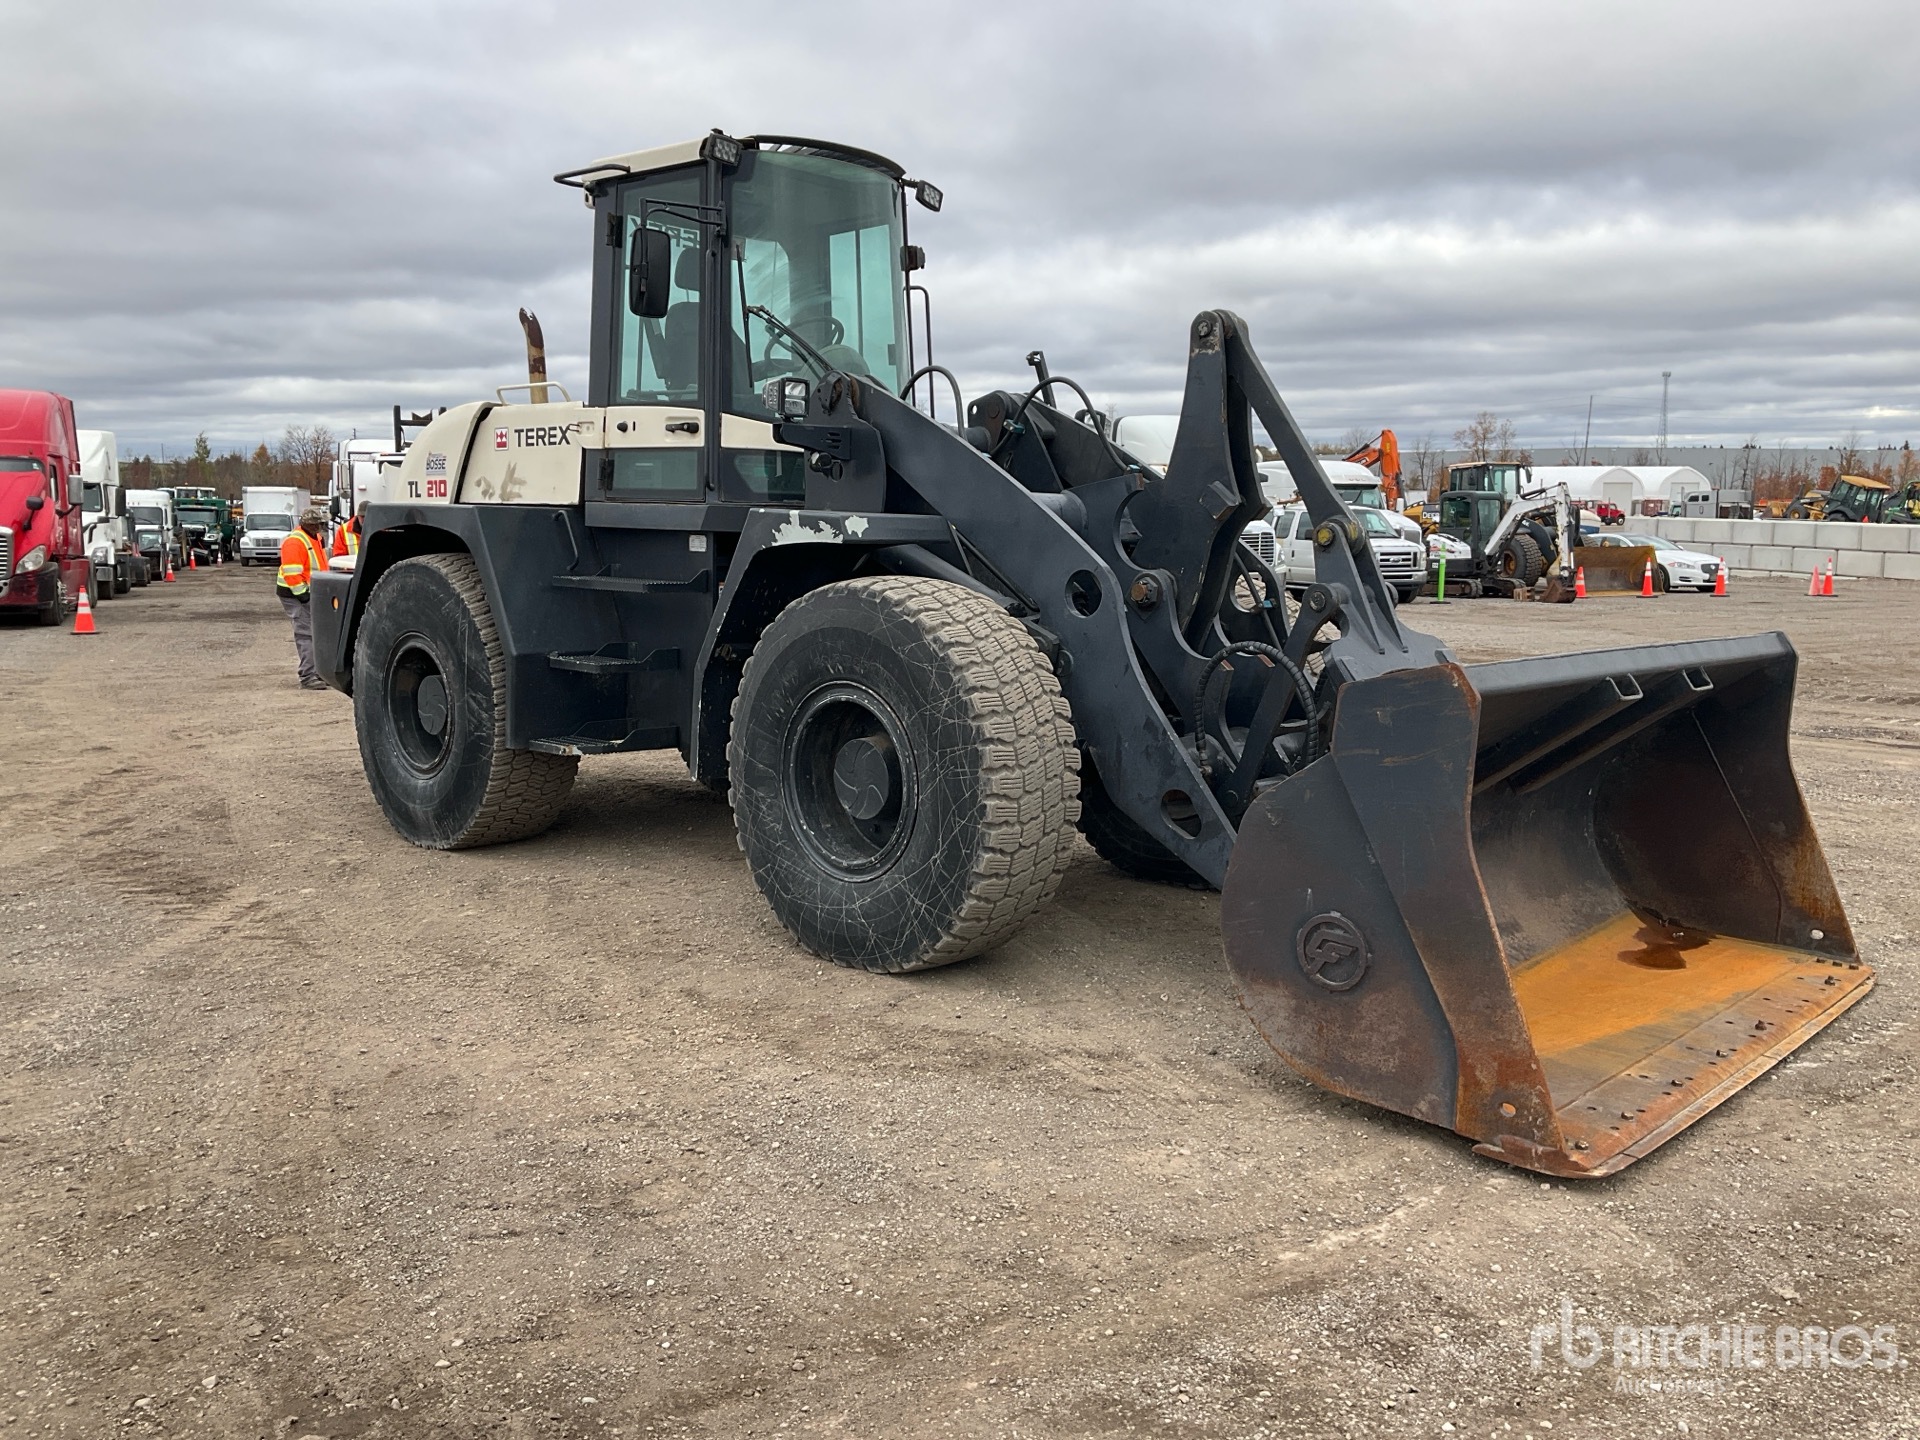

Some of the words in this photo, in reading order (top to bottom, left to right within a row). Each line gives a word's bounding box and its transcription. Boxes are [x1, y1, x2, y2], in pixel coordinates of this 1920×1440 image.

[514, 426, 571, 447] TEREX
[407, 480, 422, 498] TL
[427, 479, 448, 497] 210
[1422, 511, 1440, 519] DEER
